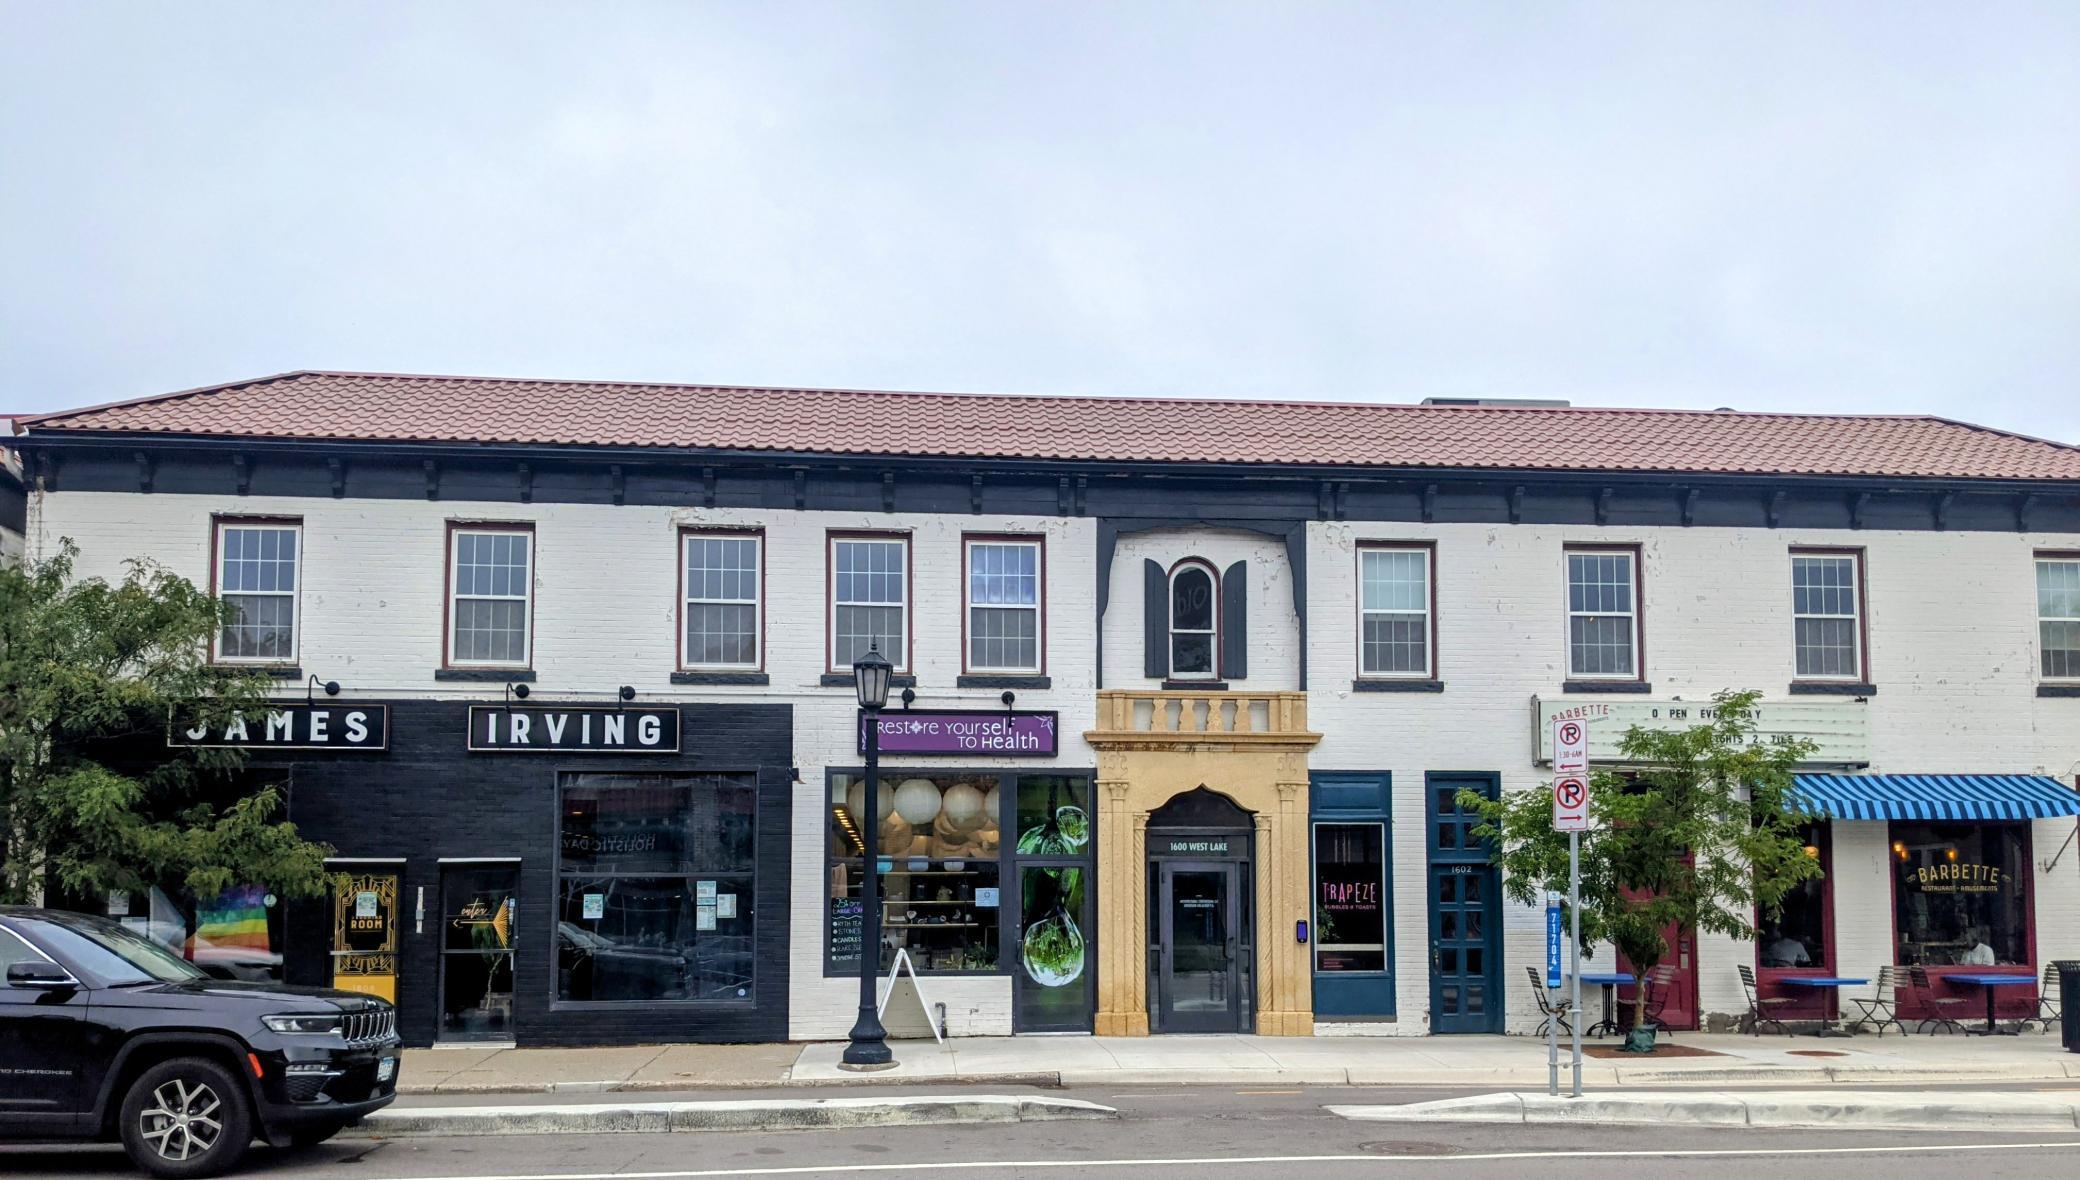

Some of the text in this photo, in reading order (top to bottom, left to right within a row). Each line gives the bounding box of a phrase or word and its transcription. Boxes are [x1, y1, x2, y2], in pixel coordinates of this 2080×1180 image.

[1551, 704, 1609, 721] BARBETTE
[186, 710, 368, 743] JAMES
[487, 713, 661, 745] IRVING
[981, 731, 1039, 749] Health
[1170, 842, 1228, 851] 1600 WEST LAKE
[1451, 865, 1472, 874] 1602
[1918, 863, 2000, 883] BARBETTE
[1322, 882, 1377, 903] TRAPEZE
[461, 897, 487, 919] enter
[351, 920, 382, 929] ROOM
